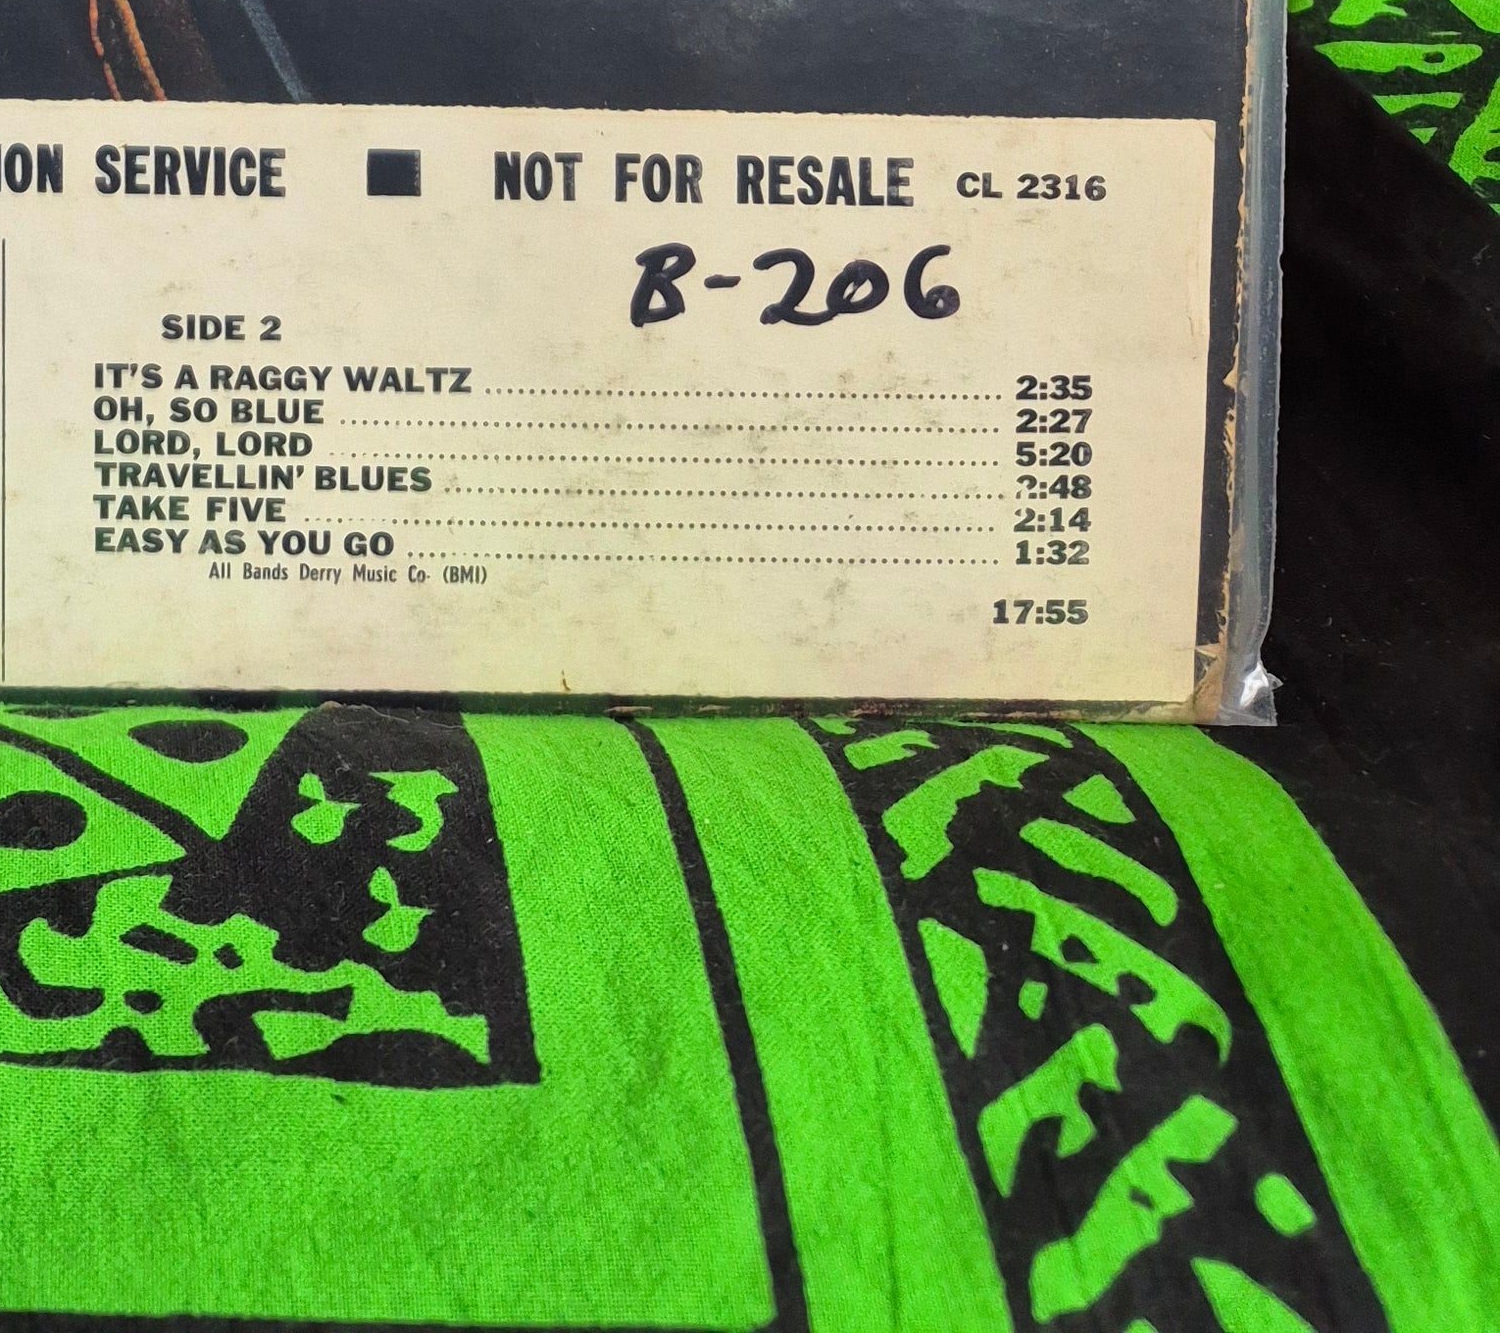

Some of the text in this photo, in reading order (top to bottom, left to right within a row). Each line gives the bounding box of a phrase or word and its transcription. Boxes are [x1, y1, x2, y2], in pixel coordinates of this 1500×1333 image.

[94, 144, 286, 198] SERVICE
[494, 151, 583, 202] NOT
[614, 152, 703, 204] FOR
[736, 155, 914, 207] RESALE
[956, 171, 1003, 200] CL
[1016, 173, 1107, 202] 2316
[630, 242, 960, 327] B-206
[161, 314, 282, 341] SIDE 2
[95, 364, 1093, 401] IT'S A RAGGY WALTZ 2:35
[94, 396, 1093, 434] OH, SO BLUE 2:27
[95, 429, 1093, 467] LORD, LORD 5:20
[95, 462, 306, 489] TRAVELLIN'
[316, 466, 432, 492] BLUES
[93, 495, 1092, 533] TAKE FIVE 2:14
[95, 528, 1091, 565] EASY AS YOU GO 1:32
[208, 562, 231, 579] All
[243, 563, 289, 581] Bands
[299, 563, 342, 584] Derry
[352, 564, 397, 583] Music
[442, 565, 487, 585] (BMI)
[992, 599, 1089, 625] 17:55
